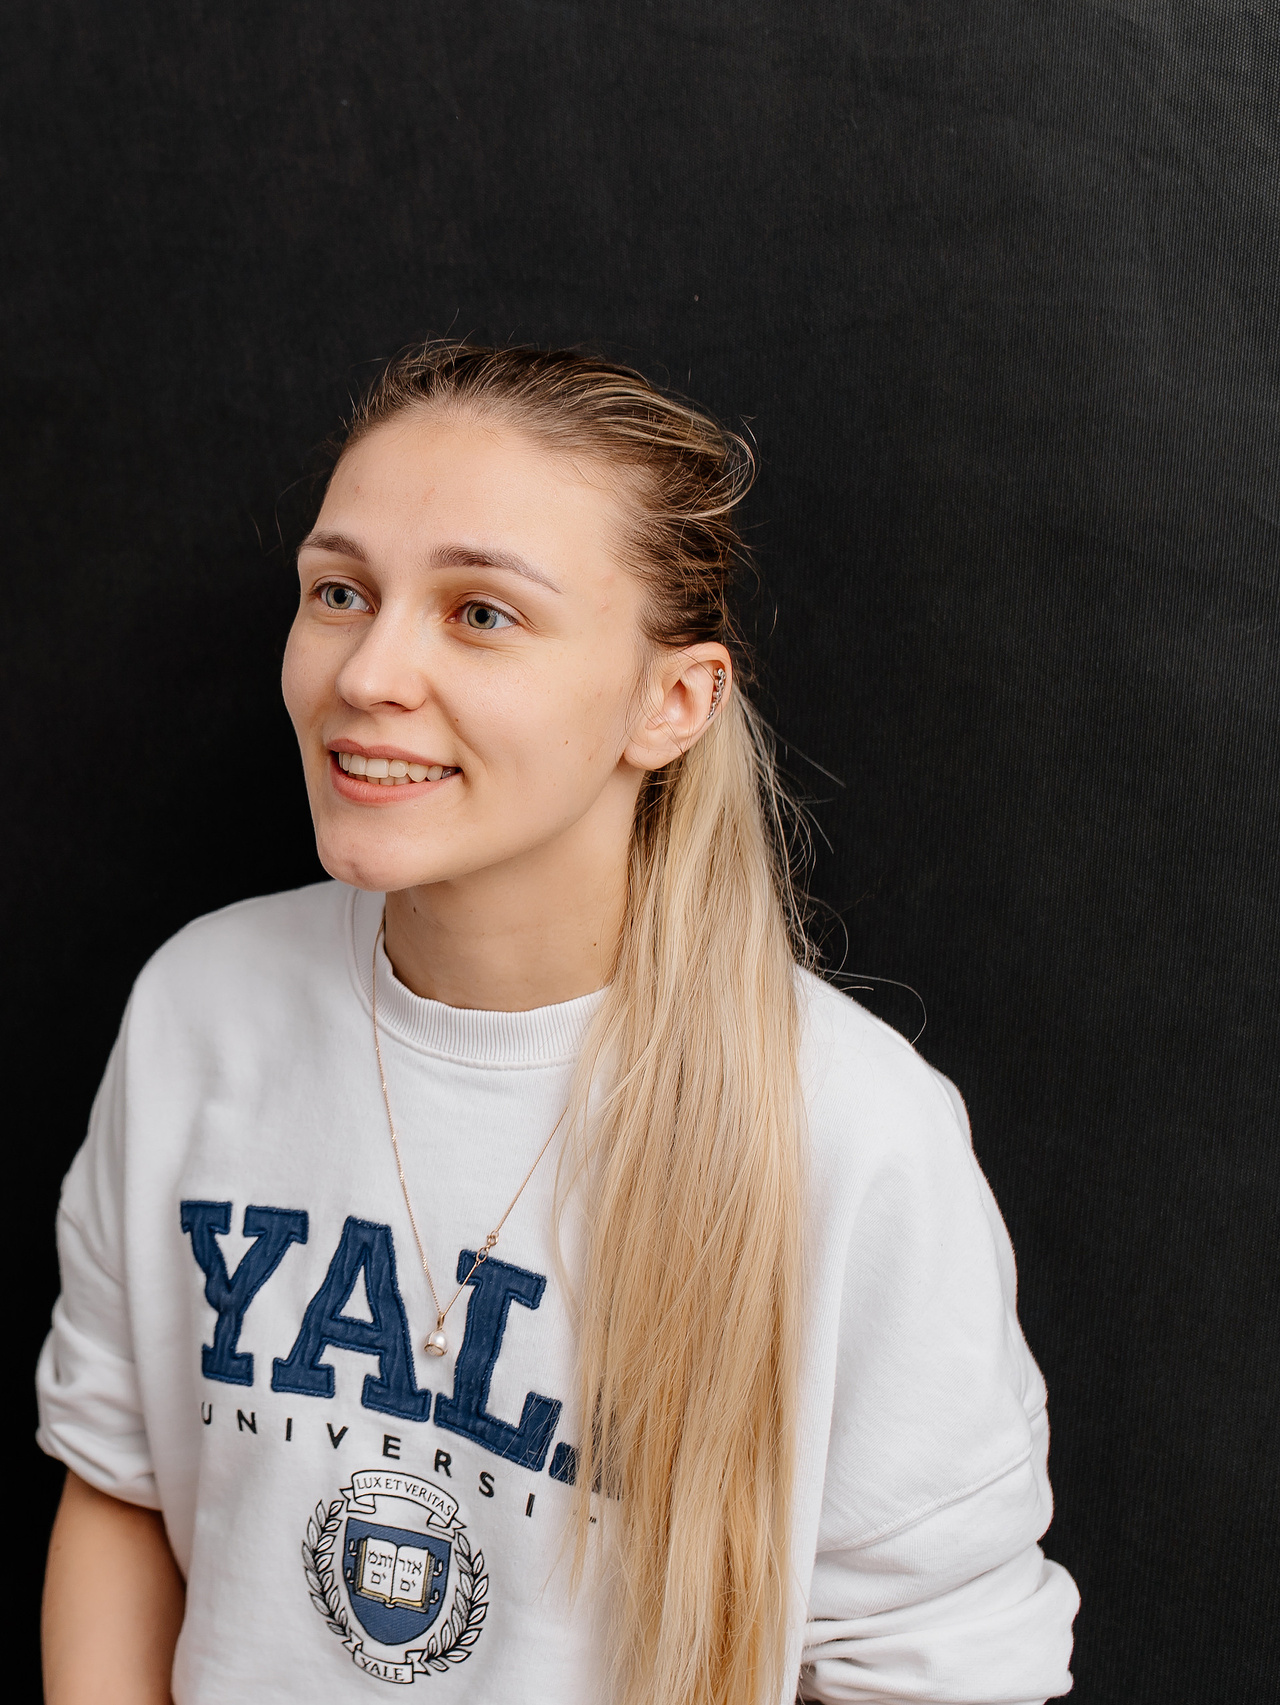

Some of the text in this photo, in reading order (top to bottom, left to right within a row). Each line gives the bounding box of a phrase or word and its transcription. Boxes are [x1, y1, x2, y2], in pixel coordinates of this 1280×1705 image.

[200, 1401, 597, 1524] UNIVERSI
[356, 1477, 455, 1516] LUX ET VERITAS
[361, 1656, 405, 1682] YALE
